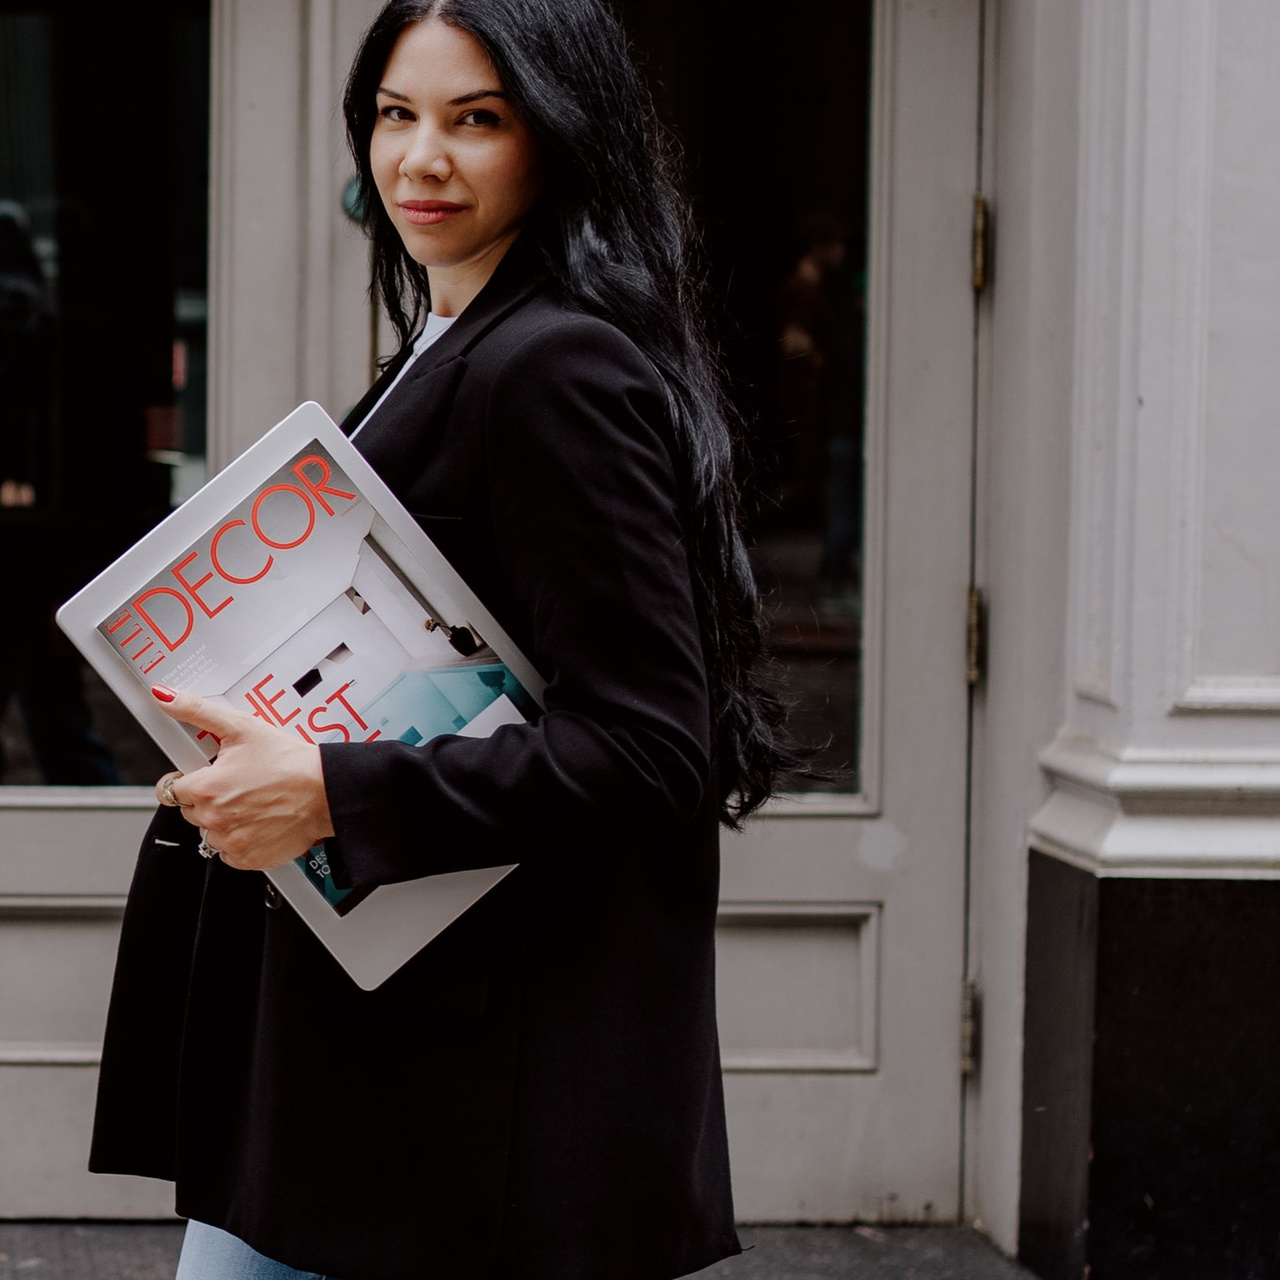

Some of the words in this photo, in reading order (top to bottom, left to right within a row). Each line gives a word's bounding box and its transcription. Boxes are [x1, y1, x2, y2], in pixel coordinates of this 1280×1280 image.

[131, 454, 357, 653] DECOR
[104, 609, 166, 675] ELLE
[316, 864, 331, 878] TO
